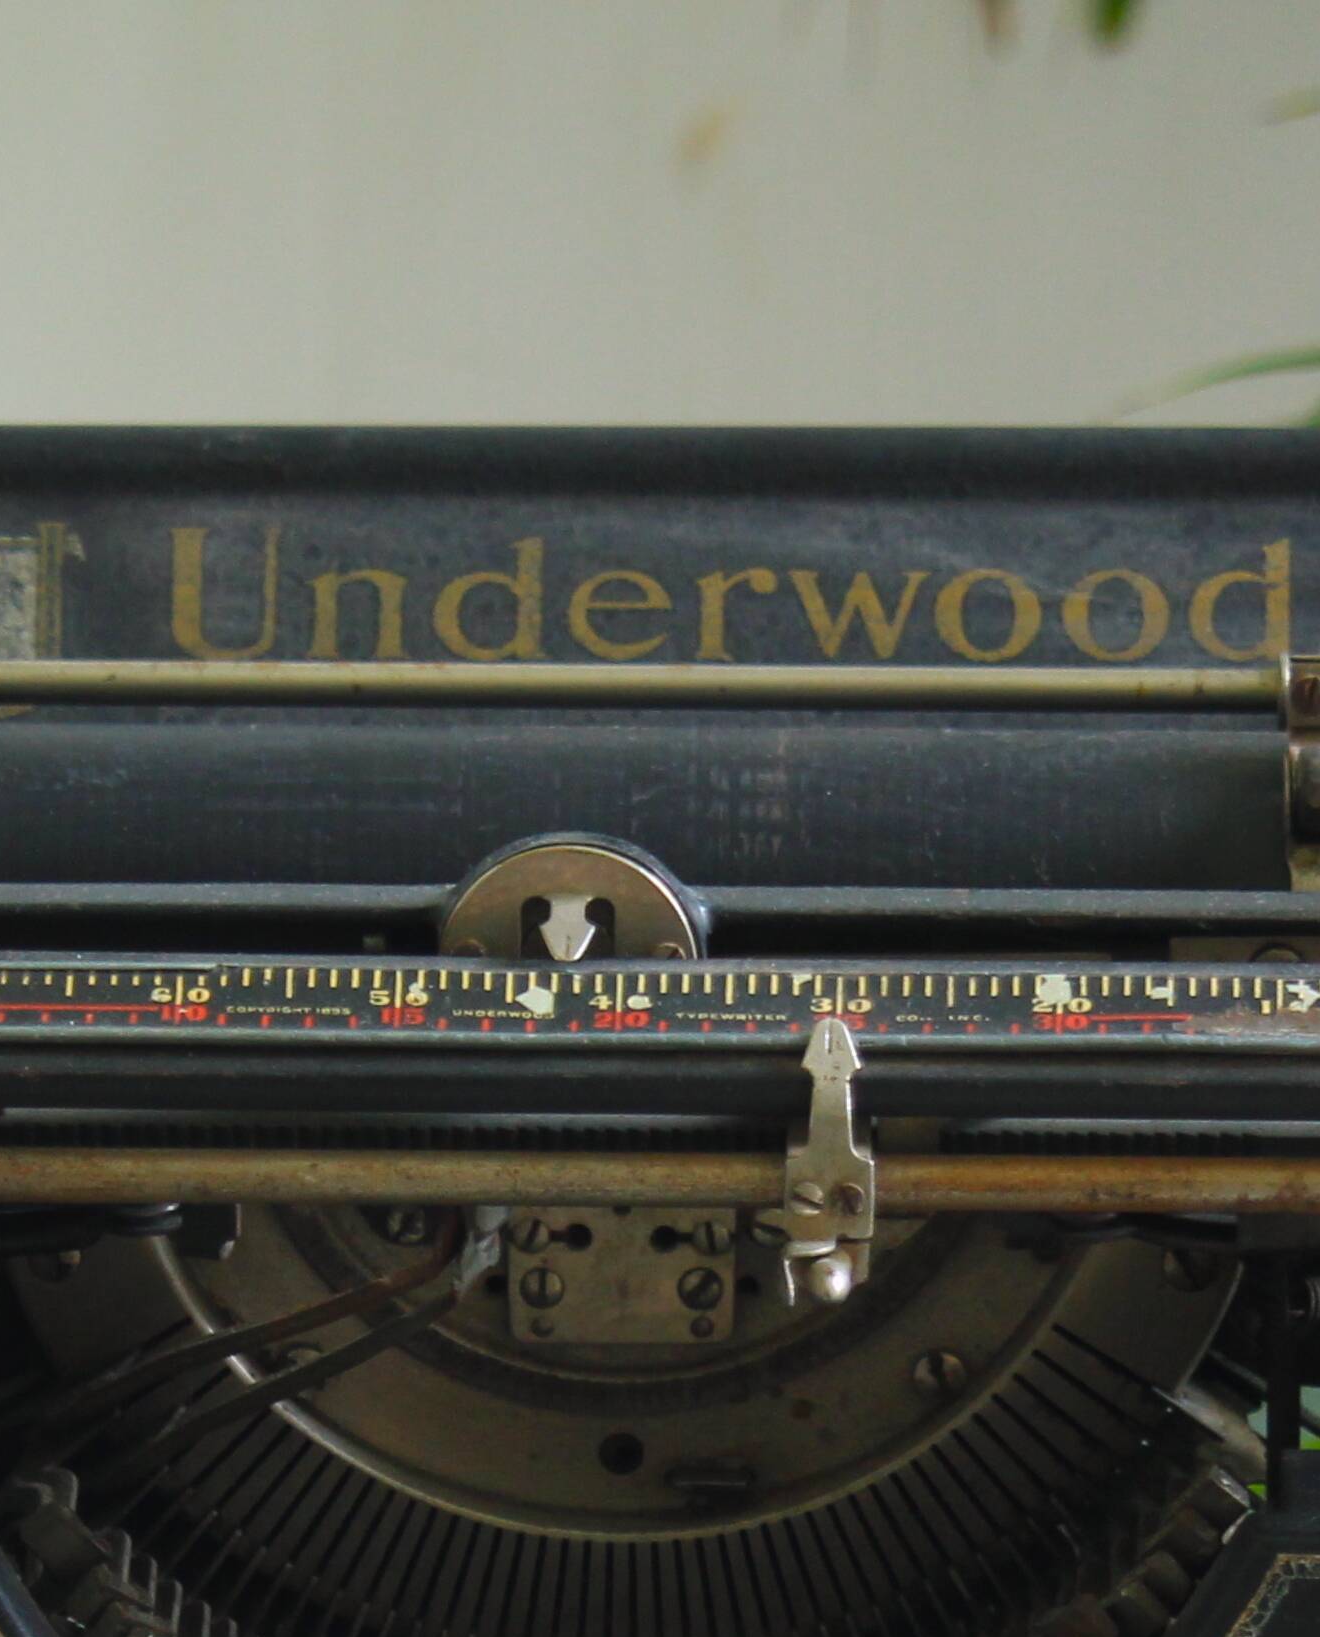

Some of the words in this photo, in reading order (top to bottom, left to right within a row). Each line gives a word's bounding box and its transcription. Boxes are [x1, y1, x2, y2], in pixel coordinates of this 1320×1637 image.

[168, 527, 1291, 664] Underwood
[151, 988, 210, 1003] 60
[810, 997, 872, 1013] 30
[226, 1005, 311, 1014] COPYRIGHT
[676, 1012, 787, 1022] TYPEWRITER
